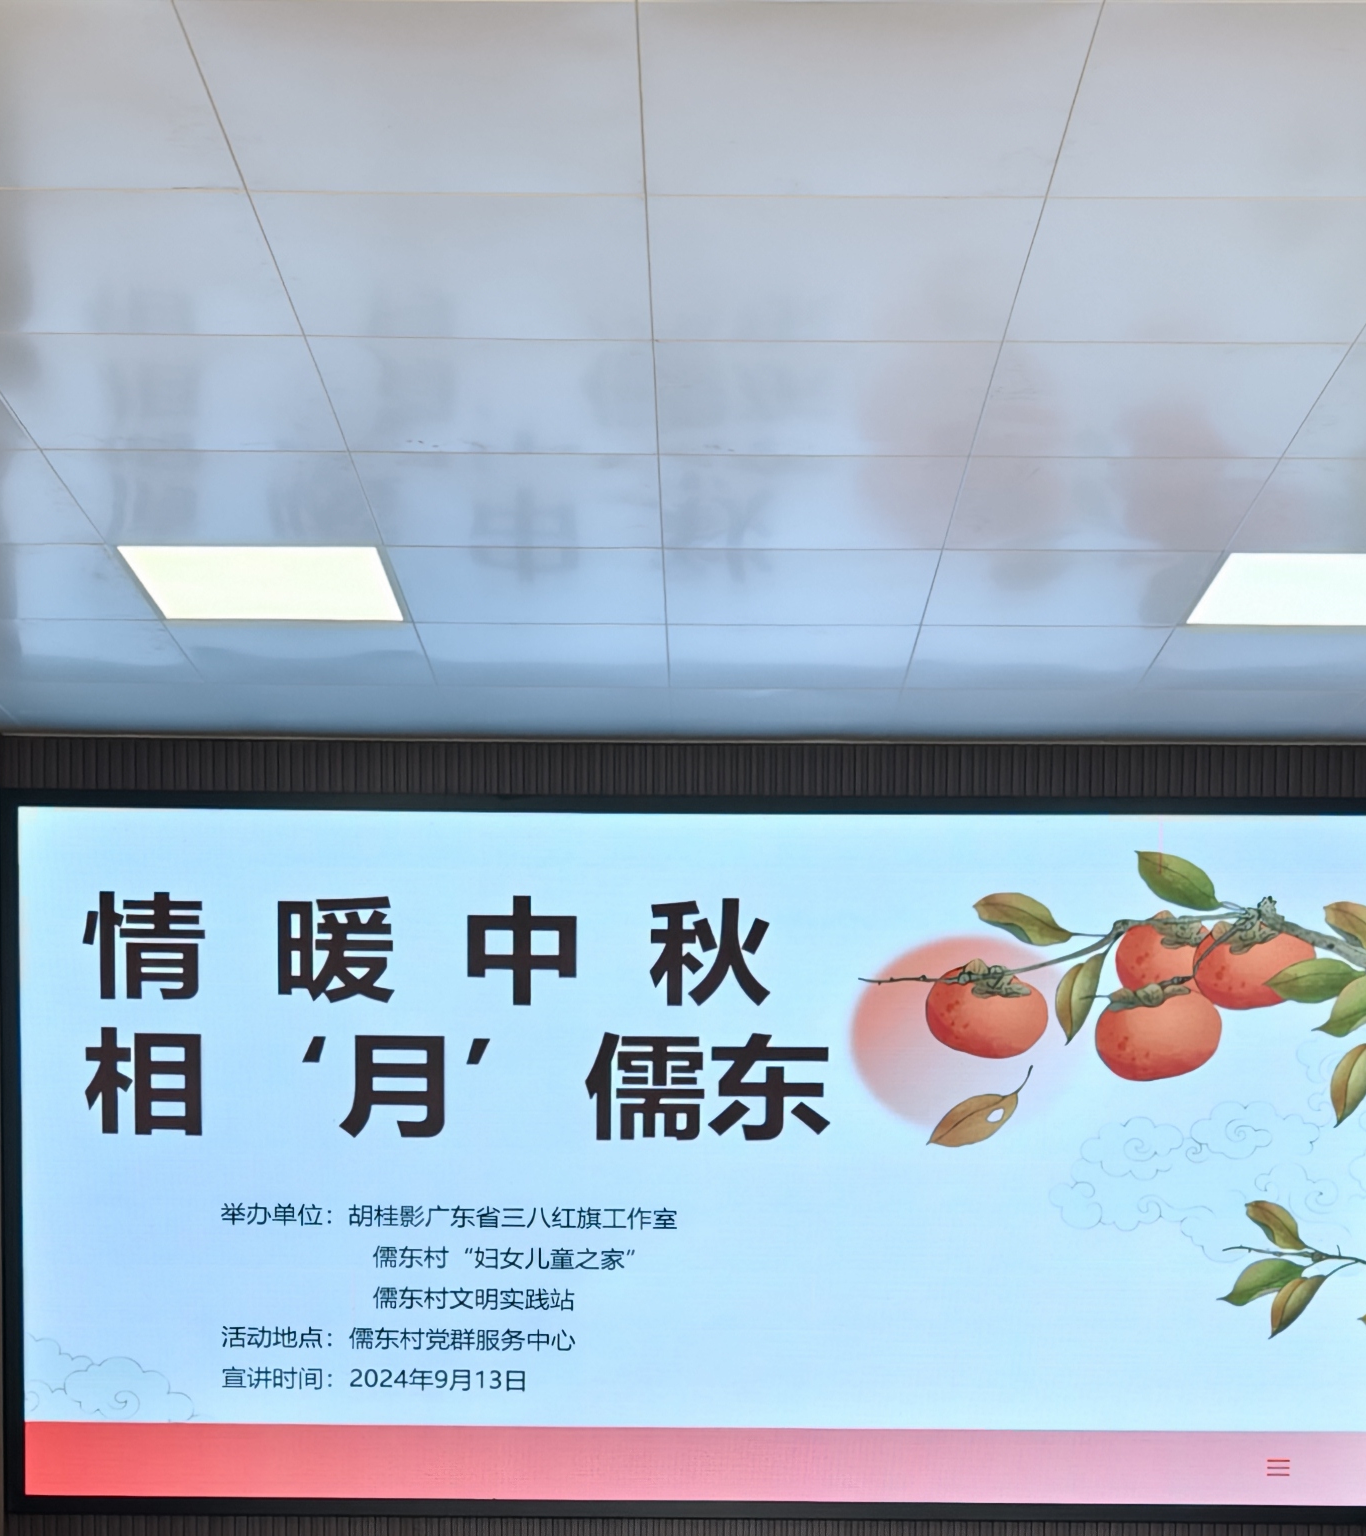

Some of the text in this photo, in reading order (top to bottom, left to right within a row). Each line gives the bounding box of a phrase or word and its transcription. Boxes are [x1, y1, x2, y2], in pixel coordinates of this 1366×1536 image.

[220, 1202, 679, 1231] 举办单位：胡桂影广东省三八红旗工作室
[372, 1286, 576, 1313] 儒东村文明实践站
[221, 1325, 577, 1353] 活动地点：儒东村党群服务中心
[221, 1366, 528, 1394] 宣讲时间：2024年9月13日
